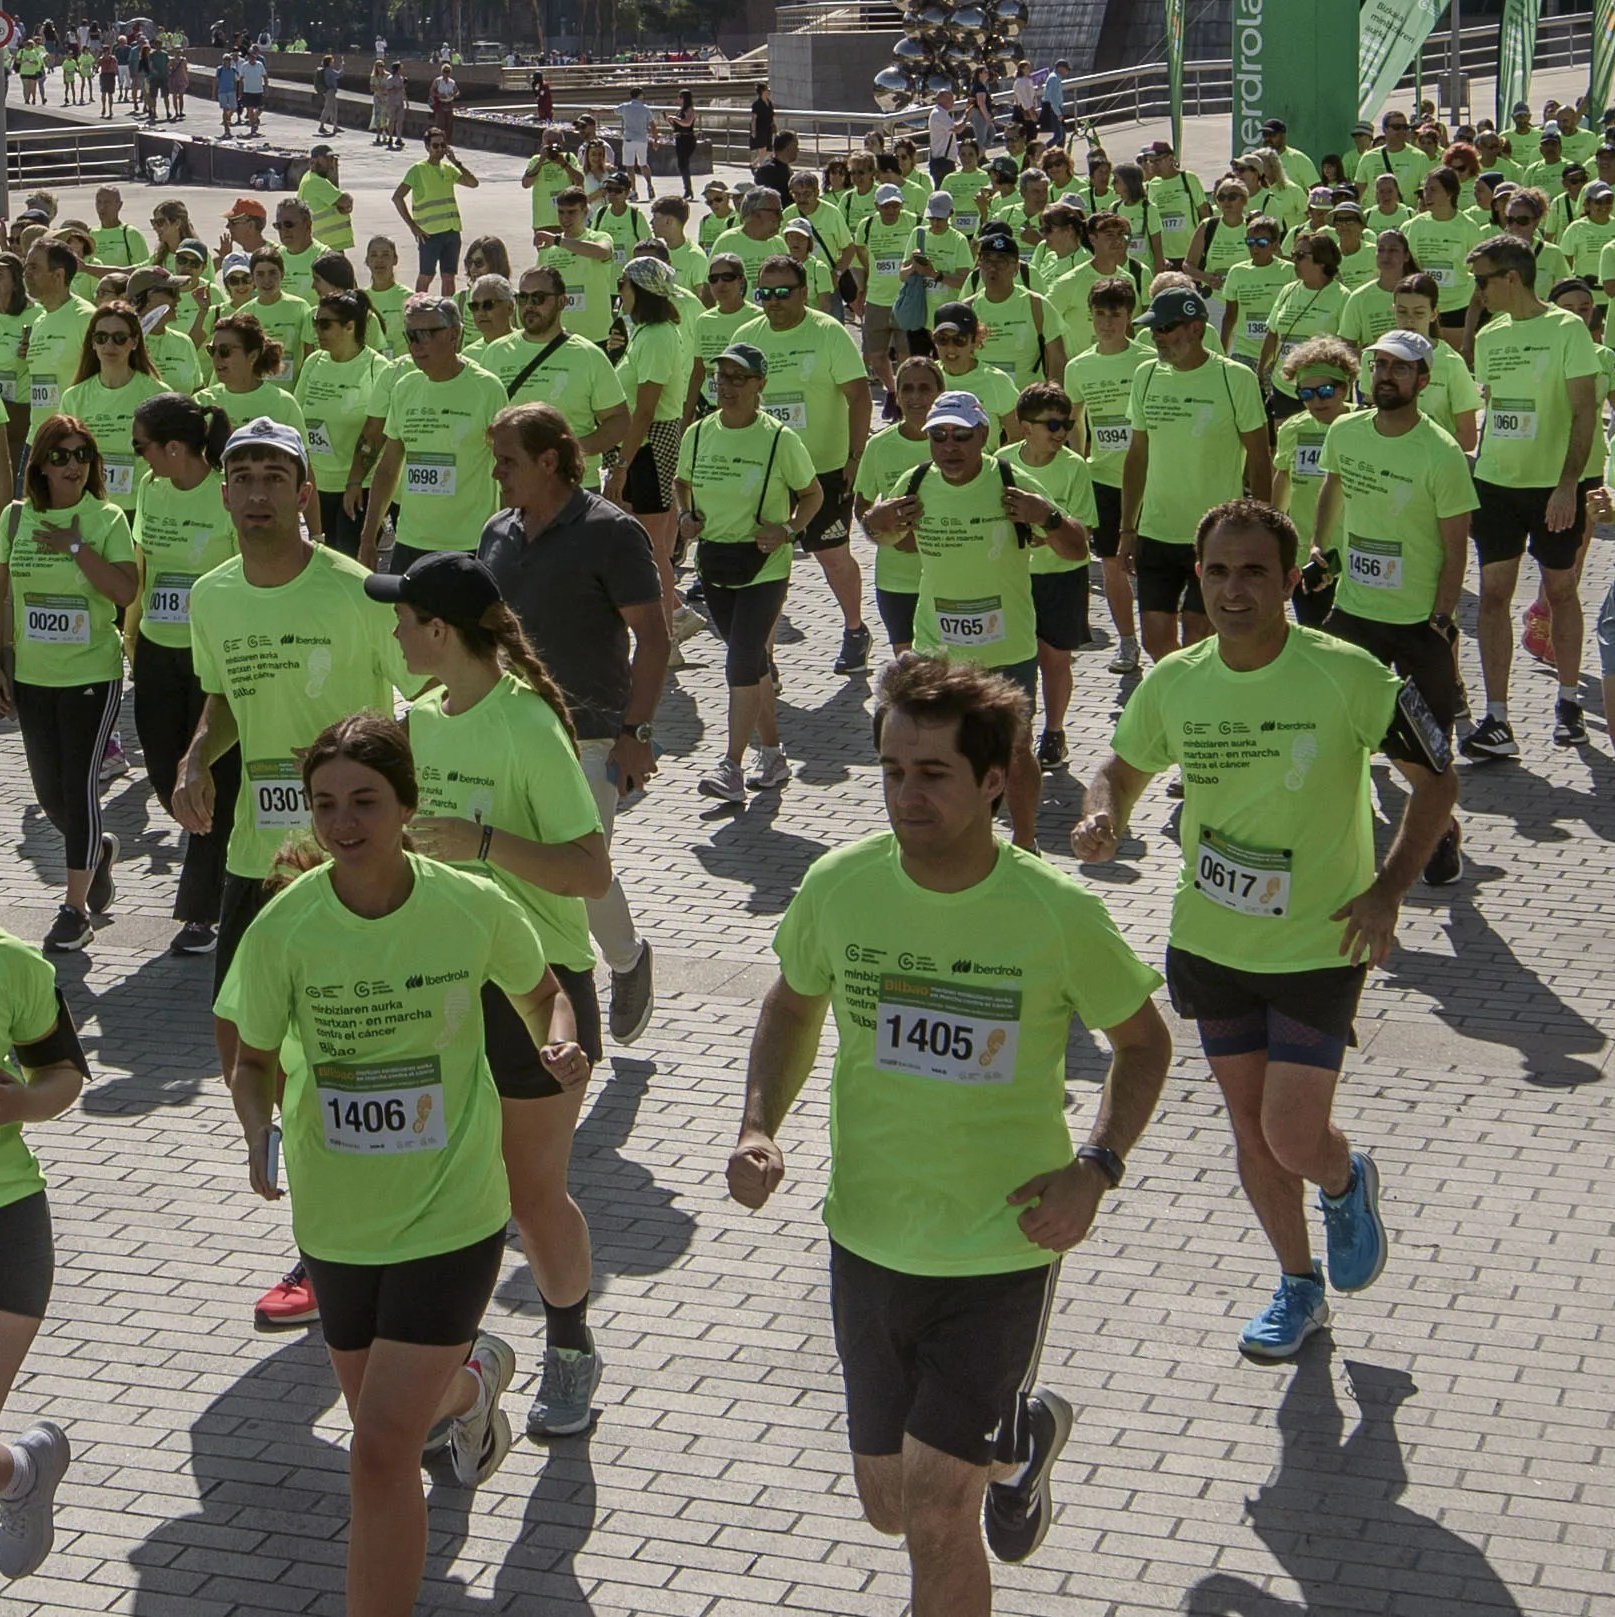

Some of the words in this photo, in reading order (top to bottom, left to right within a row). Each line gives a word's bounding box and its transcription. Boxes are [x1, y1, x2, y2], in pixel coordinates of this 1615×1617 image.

[1097, 429, 1127, 443] 0394
[408, 469, 438, 485] 0698
[1349, 554, 1381, 577] 1456
[29, 611, 69, 632] 0020
[940, 617, 983, 636] 0765
[1241, 748, 1280, 758] marcha
[1201, 855, 1257, 898] 0617
[425, 969, 469, 986] Iberdrola
[844, 968, 880, 983] minbiz
[973, 963, 1023, 977] Iberdrola
[884, 979, 930, 996] Bilbao
[371, 1000, 403, 1012] aurka
[846, 997, 876, 1009] contra
[314, 1016, 357, 1029] martxan
[366, 1016, 382, 1026] en
[385, 1008, 432, 1024] marcha
[345, 1031, 355, 1040] el
[358, 1027, 396, 1038] cáncer
[886, 1013, 974, 1061] 1405
[328, 1097, 406, 1133] 1406
